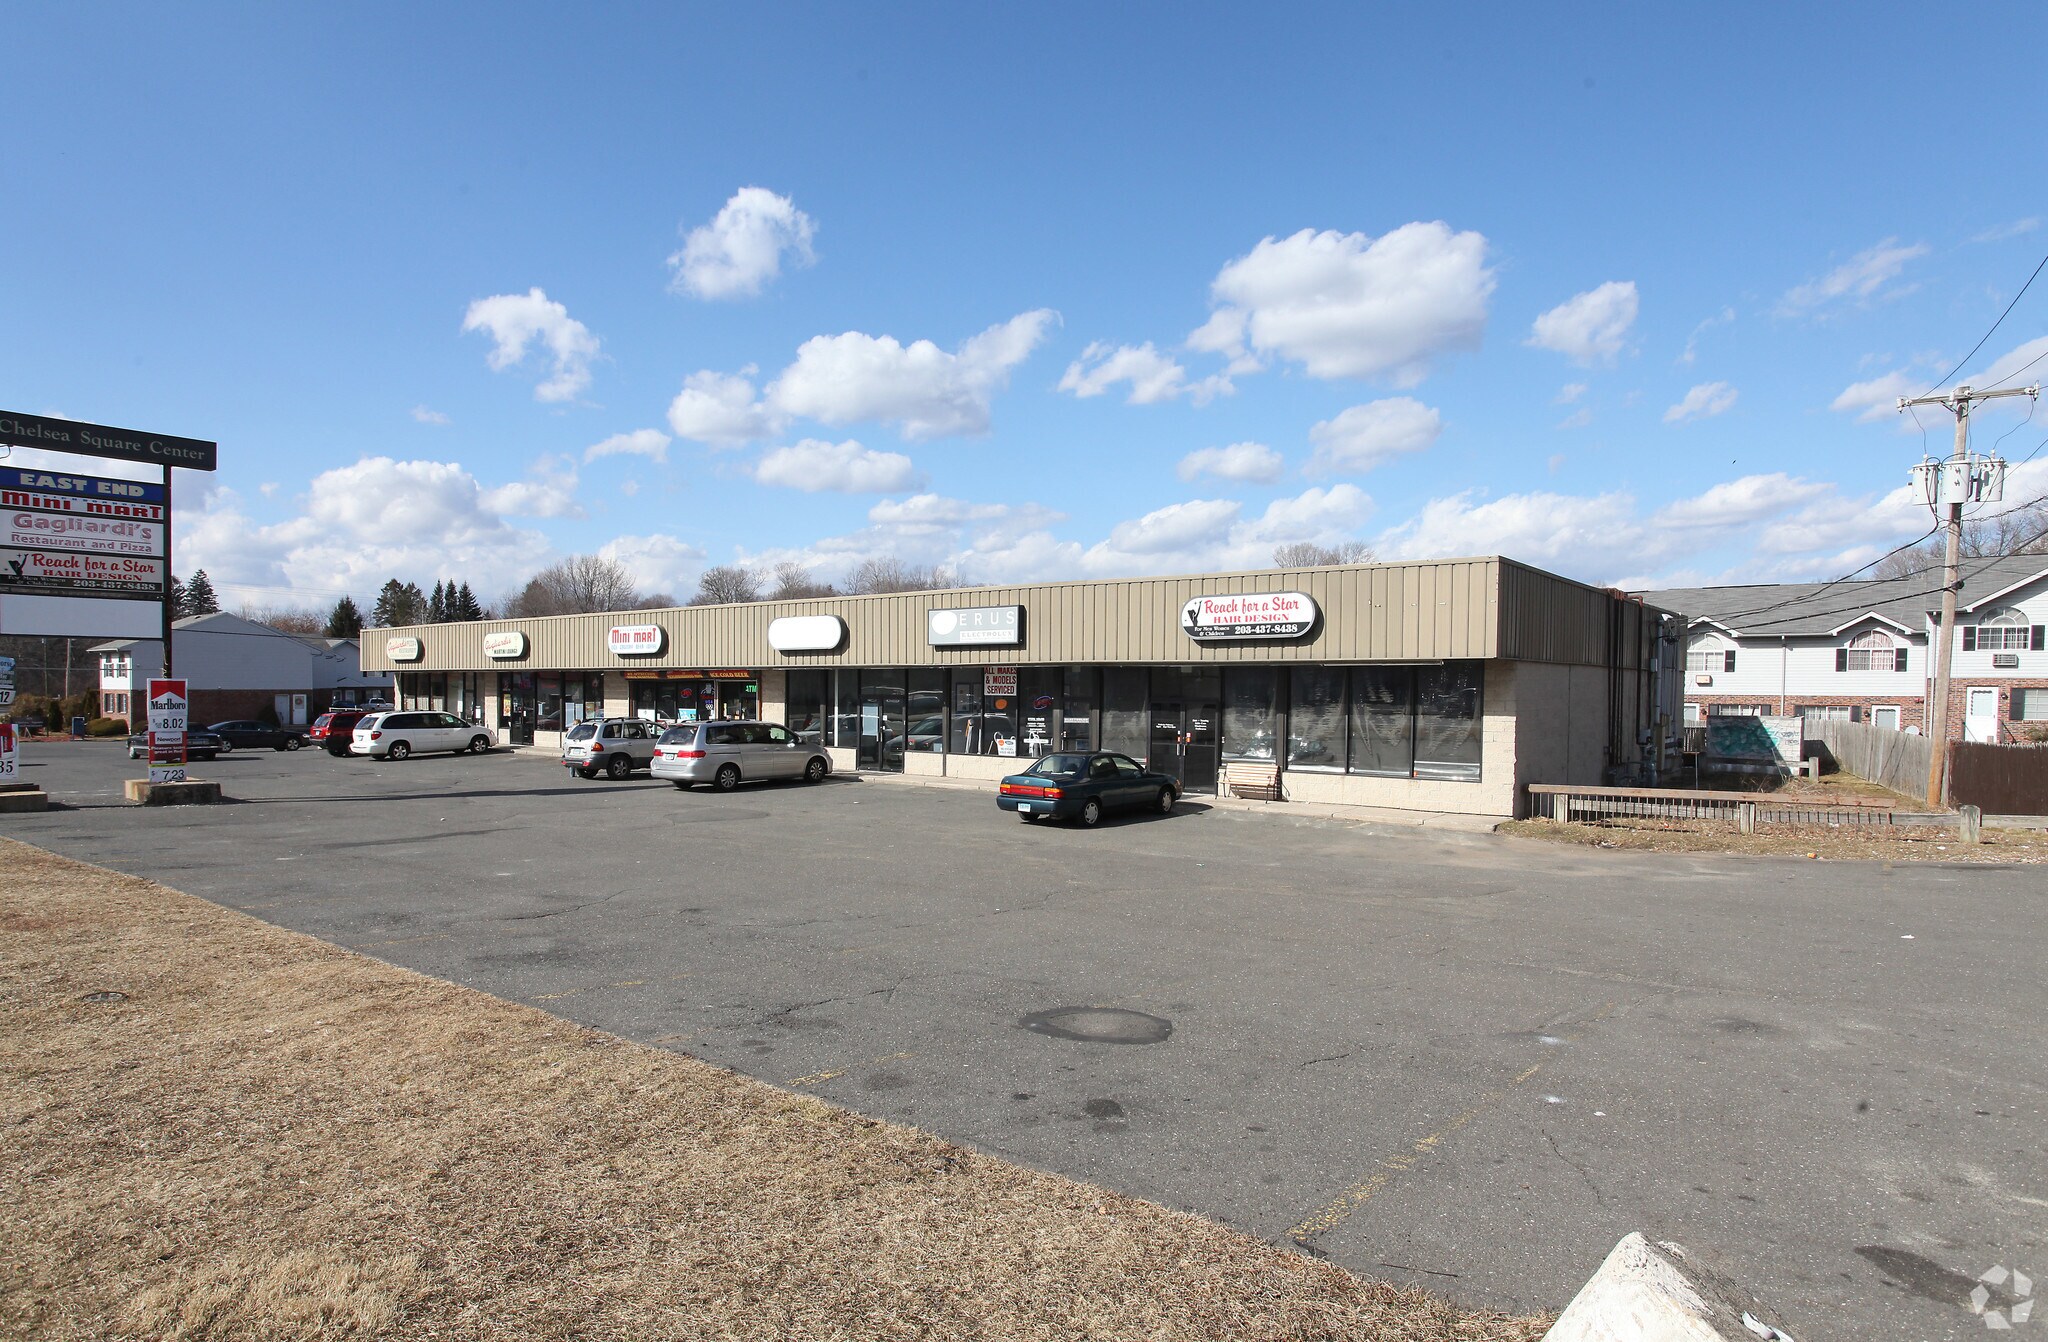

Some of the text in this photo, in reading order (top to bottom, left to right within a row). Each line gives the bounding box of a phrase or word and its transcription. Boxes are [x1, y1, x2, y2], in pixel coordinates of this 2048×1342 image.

[0, 419, 205, 460] Chelsea Square Center
[20, 473, 144, 497] EAST END
[13, 513, 152, 540] Gagliardi's
[11, 534, 152, 553] Restaurant and Pizza
[31, 553, 156, 573] Reach for a Star
[43, 569, 143, 581] HAIR DESIGN
[73, 579, 156, 591] 203-437-8438
[1204, 598, 1237, 614] Reach
[1241, 598, 1259, 614] for
[1272, 596, 1299, 611] Star
[1213, 613, 1290, 624] HAIR DESIGN
[1235, 624, 1298, 635] 203-437-8438
[997, 667, 1017, 675] MAKES
[985, 675, 1016, 684] & MODELS
[987, 685, 1015, 694] SERVICED
[151, 698, 186, 710] Marlboro
[163, 718, 184, 729] 8.02
